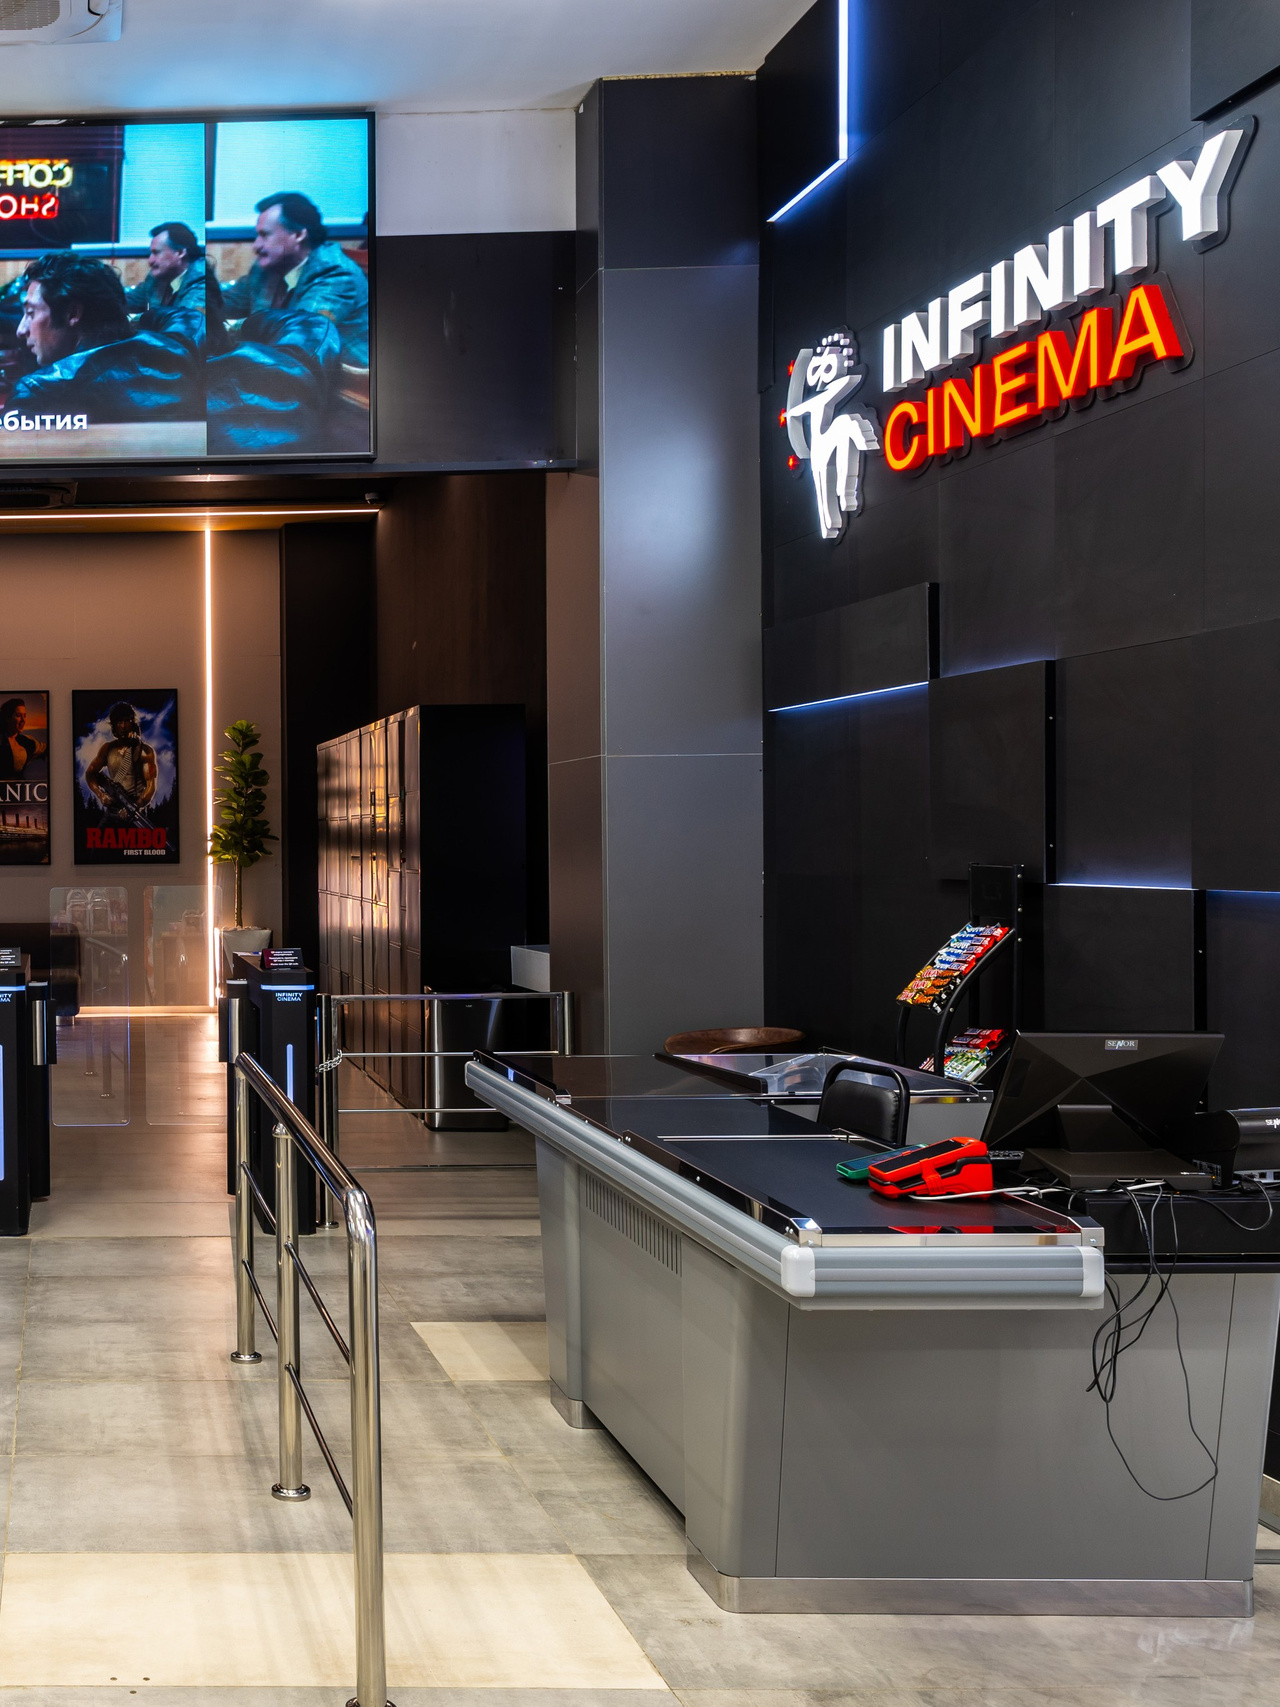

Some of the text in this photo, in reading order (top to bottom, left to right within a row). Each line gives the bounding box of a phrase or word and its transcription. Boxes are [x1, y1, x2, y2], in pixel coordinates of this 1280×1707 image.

[883, 129, 1244, 393] INFINITY
[884, 284, 1184, 472] CINEMA
[86, 827, 167, 849] RAMBO
[1107, 1040, 1135, 1050] SENOR
